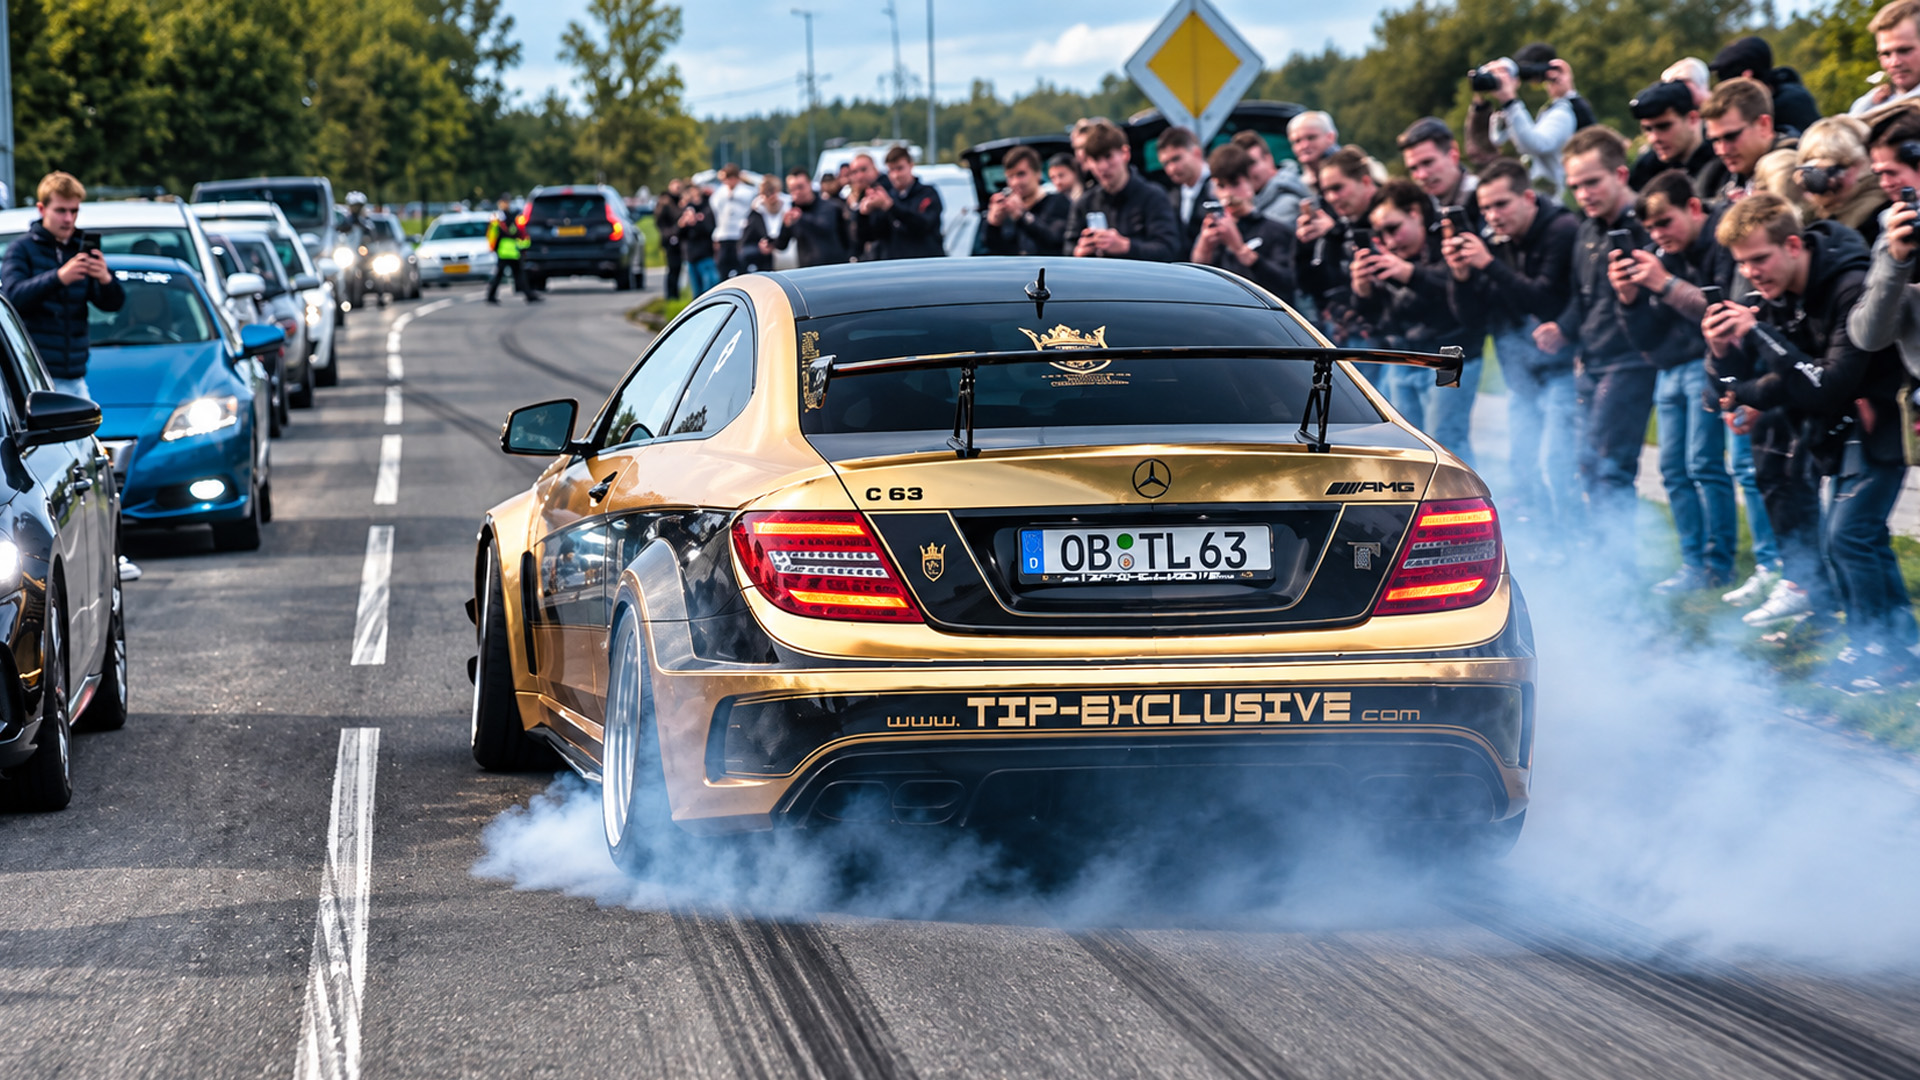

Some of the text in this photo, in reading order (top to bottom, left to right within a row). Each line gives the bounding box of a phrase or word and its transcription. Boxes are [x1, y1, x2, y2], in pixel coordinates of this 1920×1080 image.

[866, 487, 924, 501] C 63
[1357, 482, 1415, 493] AMG
[1060, 531, 1248, 571] OB TL 63
[1029, 557, 1039, 569] D
[966, 692, 1351, 727] TIP-EXCLUSIVE
[1361, 709, 1420, 721] com
